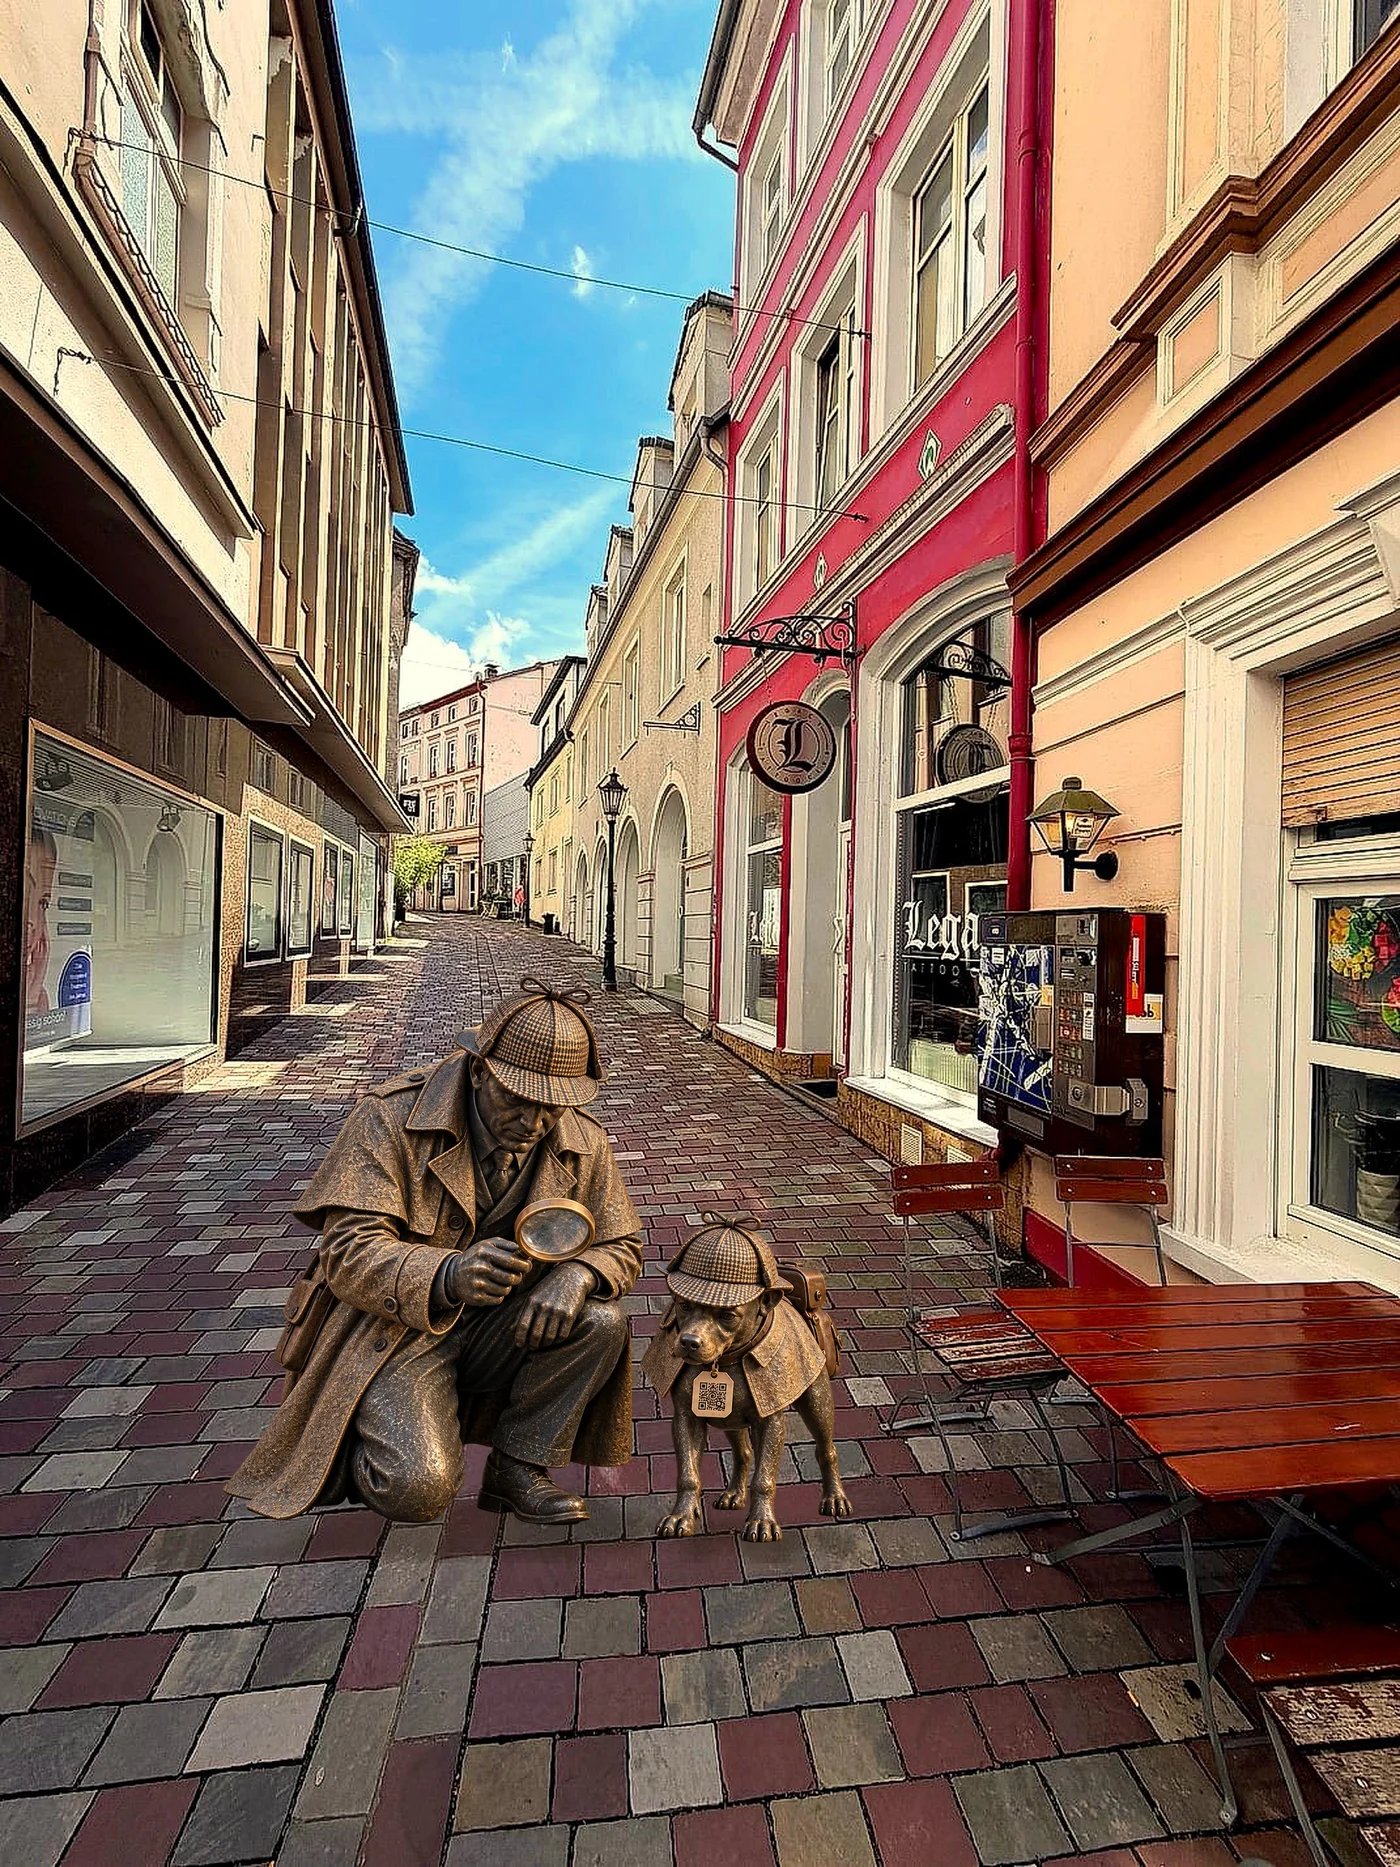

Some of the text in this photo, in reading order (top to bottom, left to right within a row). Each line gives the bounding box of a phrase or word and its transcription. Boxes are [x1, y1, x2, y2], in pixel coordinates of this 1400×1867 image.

[757, 747, 801, 784] TATTOO
[772, 717, 817, 771] L
[901, 900, 980, 961] Lega
[903, 962, 960, 977] TATTOO
